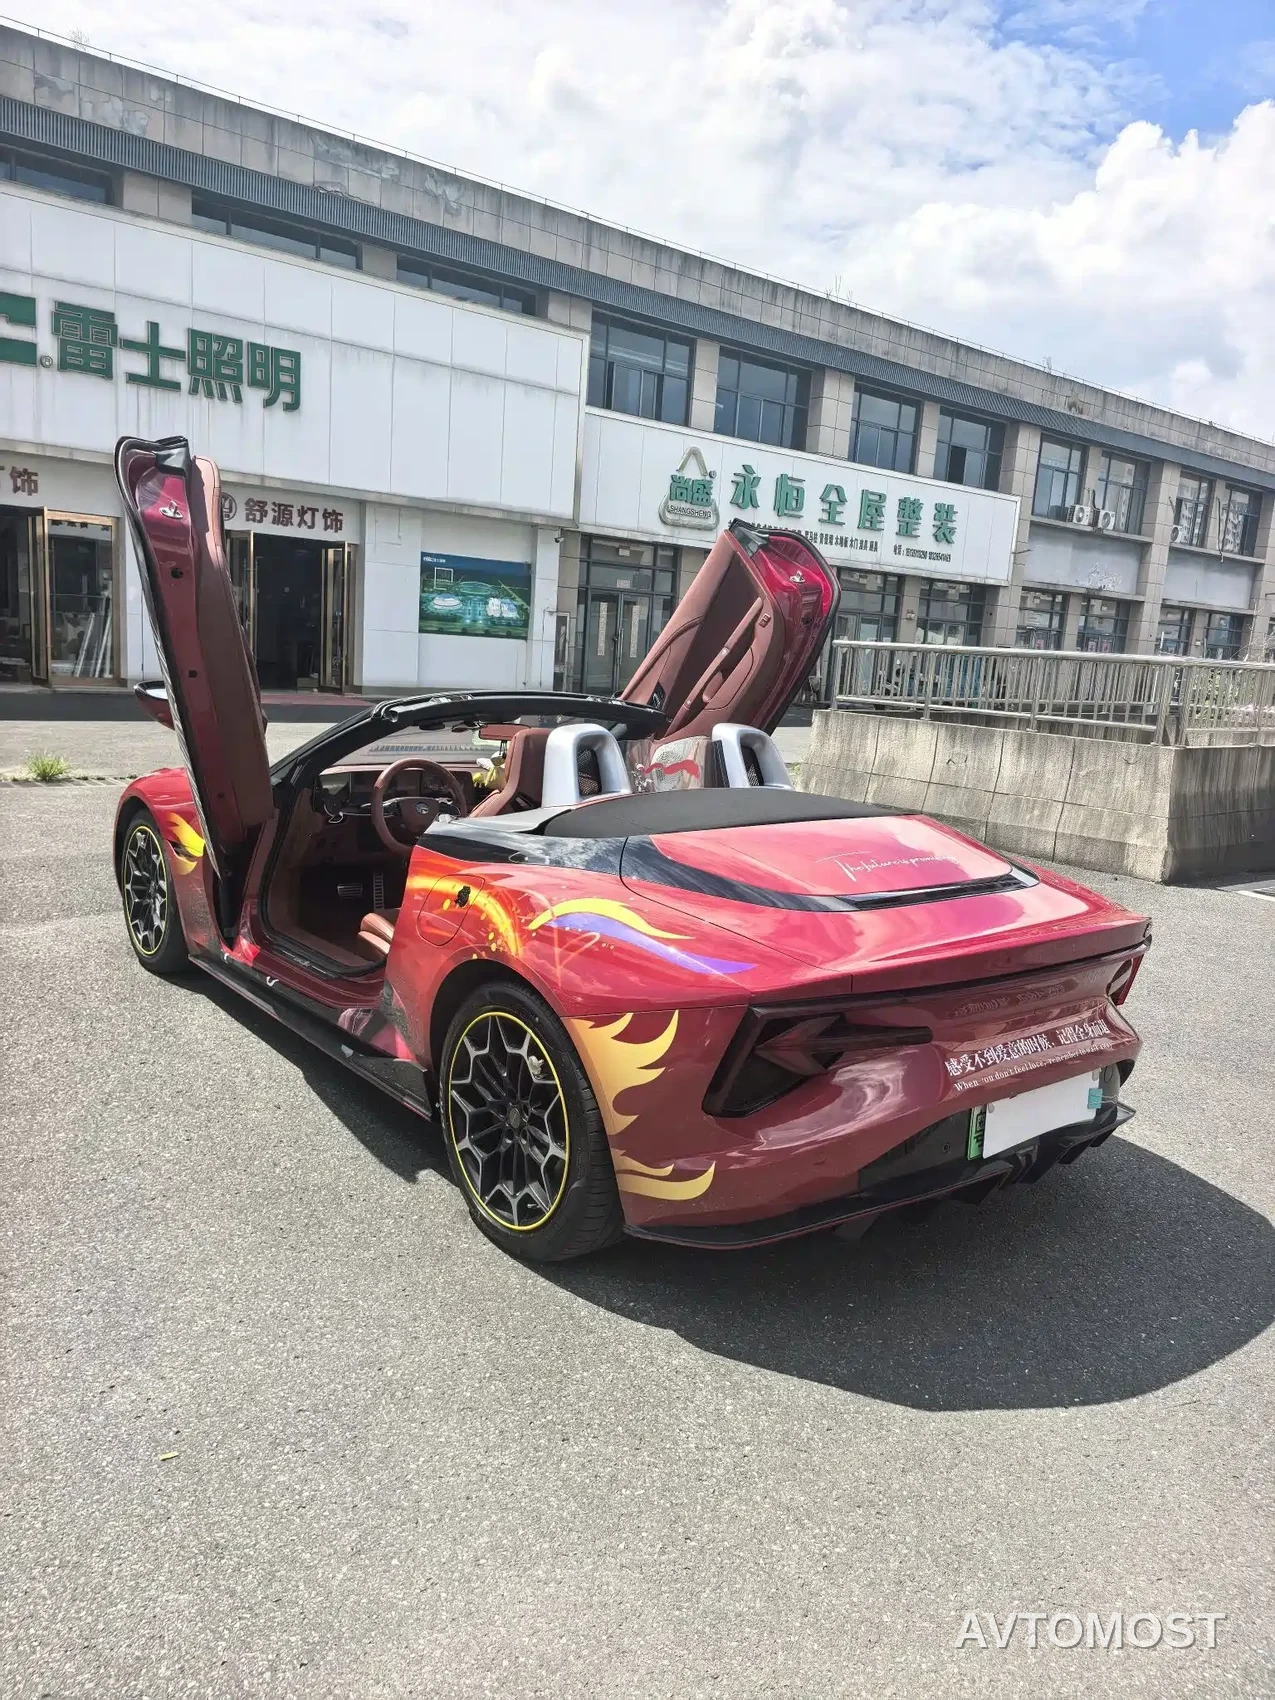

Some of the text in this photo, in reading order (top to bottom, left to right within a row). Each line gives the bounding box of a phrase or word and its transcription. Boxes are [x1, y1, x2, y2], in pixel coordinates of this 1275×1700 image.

[51, 300, 301, 412] 雷士照明
[244, 497, 344, 533] 舒源灯饰
[668, 504, 712, 519] SHANGSHENG
[729, 464, 959, 544] 永恒全屋整装
[954, 1077, 979, 1092] When
[994, 1068, 1012, 1080] don't
[1013, 1063, 1029, 1074] feel
